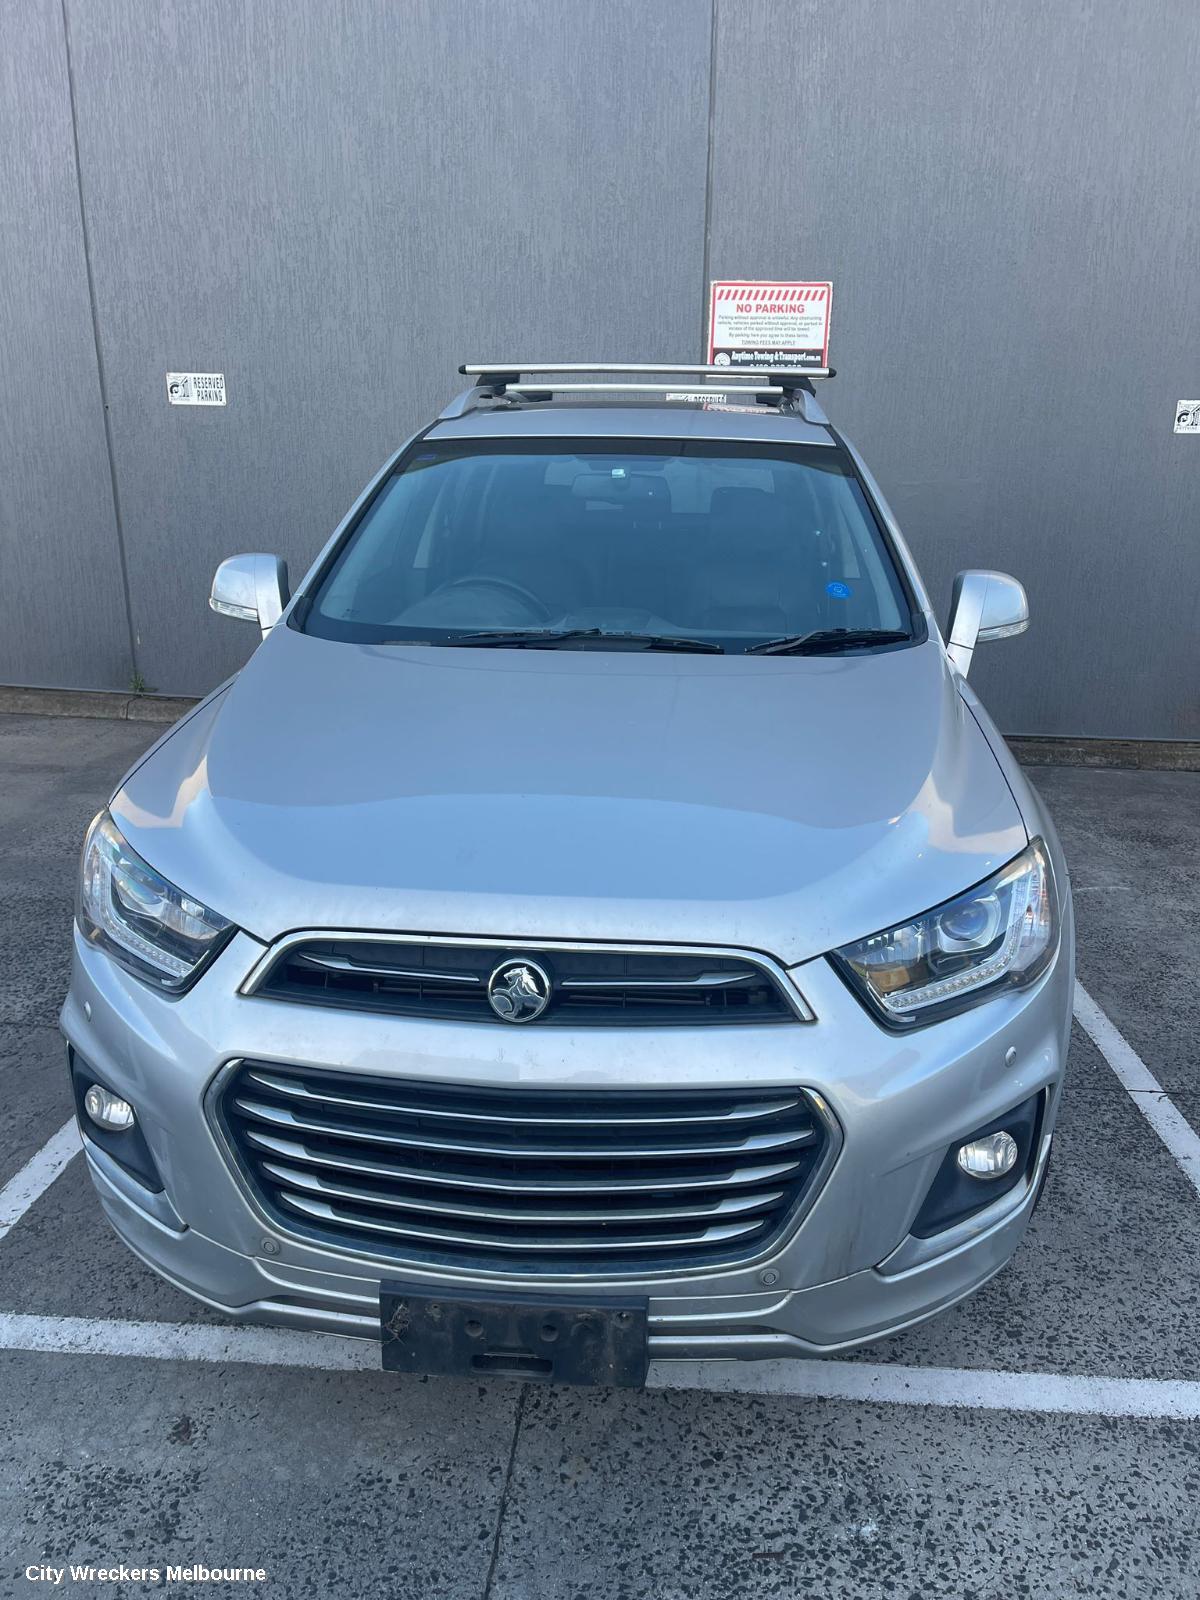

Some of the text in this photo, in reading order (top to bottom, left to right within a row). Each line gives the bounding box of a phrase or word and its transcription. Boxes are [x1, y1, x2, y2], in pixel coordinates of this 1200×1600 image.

[736, 304, 805, 313] NO PARKING
[754, 351, 774, 362] Towing
[193, 377, 223, 389] RESERVED
[197, 390, 222, 401] PARKING
